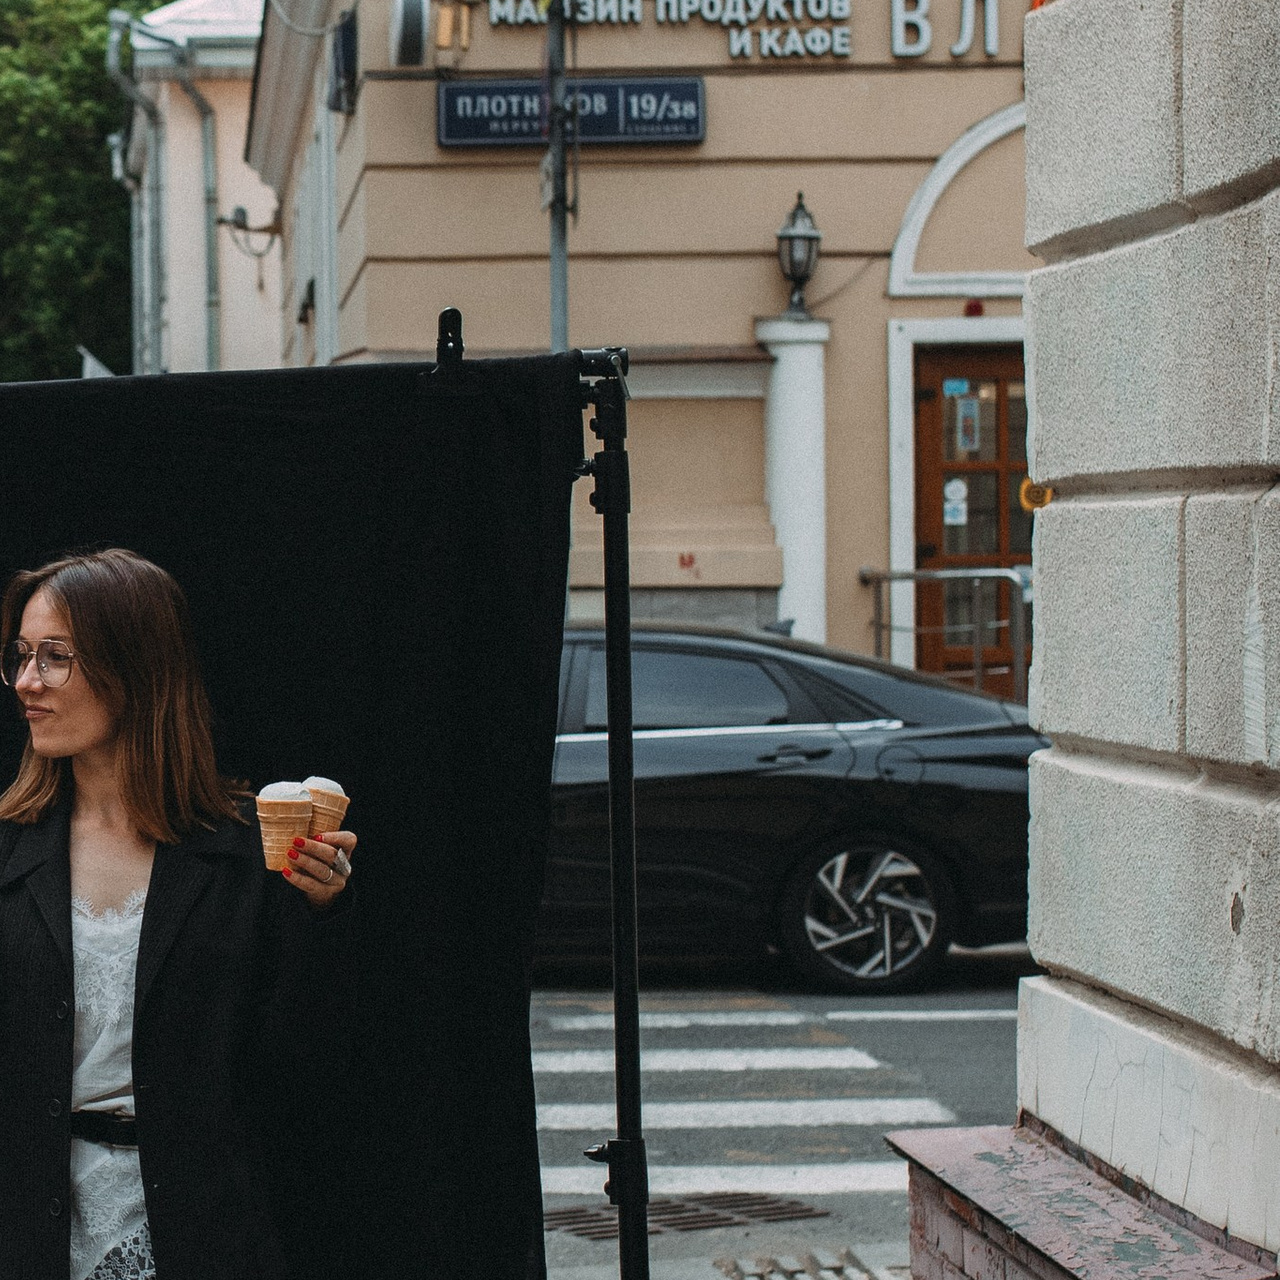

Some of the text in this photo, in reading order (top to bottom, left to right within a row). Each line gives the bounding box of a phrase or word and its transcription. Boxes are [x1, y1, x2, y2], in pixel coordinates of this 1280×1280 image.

[728, 27, 852, 58] И КАФЕ
[456, 92, 697, 121] ПЛОТНОВ 19/38
